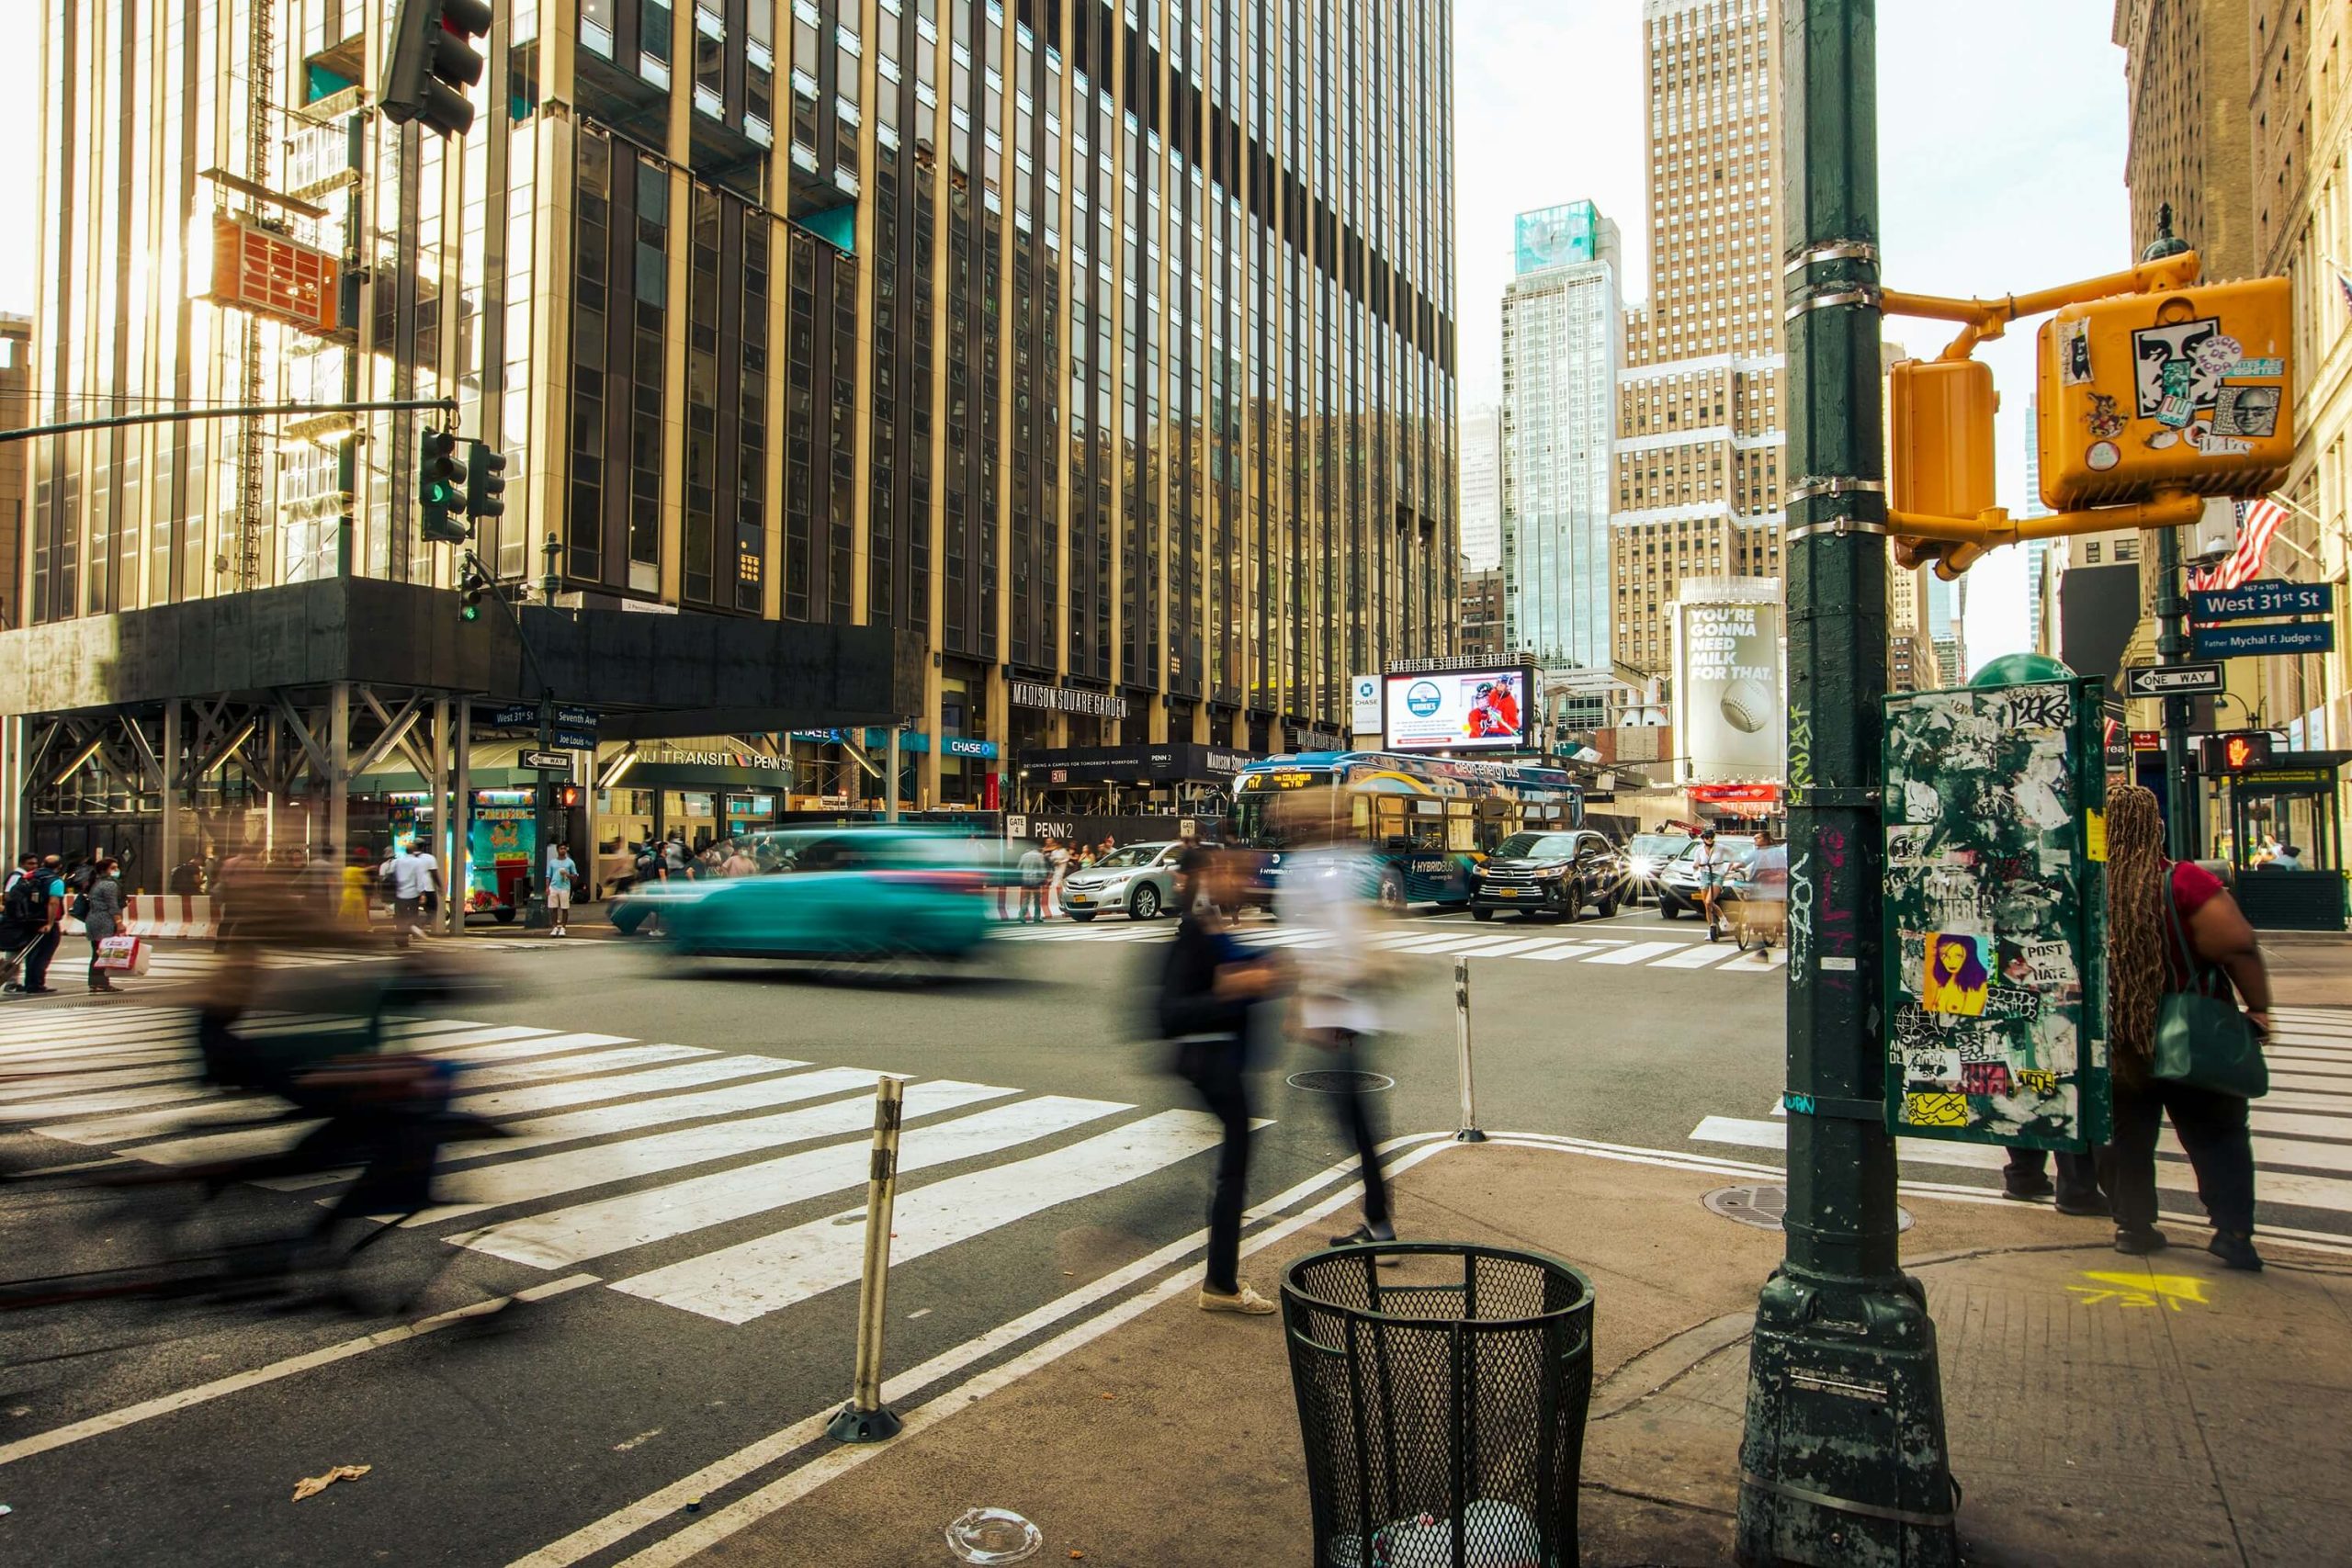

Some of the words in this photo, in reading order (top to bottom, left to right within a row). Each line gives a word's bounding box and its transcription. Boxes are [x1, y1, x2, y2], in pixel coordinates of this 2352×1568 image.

[2206, 337, 2242, 355] CICLO
[2210, 349, 2228, 359] DE
[2198, 355, 2233, 372] MODA
[2206, 595, 2256, 613] West
[2260, 592, 2294, 610] 31st
[2299, 592, 2320, 607] St
[1690, 608, 1756, 622] YOU'RE
[1690, 623, 1757, 637] GONNA
[1690, 637, 1736, 651] NEED
[2205, 639, 2228, 648] Father
[2230, 634, 2267, 648] Mychal
[2269, 635, 2278, 644] F.
[2279, 633, 2312, 646] Judge
[1391, 657, 1434, 672] MADISON
[1440, 655, 1476, 671] SQUARE
[1481, 652, 1521, 667] GARDEN
[1690, 651, 1737, 665] MILK
[1690, 666, 1727, 680] FOR
[1731, 666, 1773, 680] THAT.
[2144, 675, 2168, 686] ONE
[2180, 672, 2208, 683] WAY
[1012, 682, 1056, 709] MADISON
[1057, 687, 1093, 714] SQUARE
[1094, 695, 1127, 718] GARDEN
[496, 714, 513, 724] West
[526, 711, 534, 720] St
[559, 712, 584, 724] Seventh
[584, 716, 597, 726] Ave
[559, 734, 570, 744] Joe
[570, 736, 584, 746] Louis
[951, 741, 981, 753] CHASE
[637, 750, 657, 763] NJ
[662, 750, 731, 766] TRANSIT
[753, 755, 780, 771] PENN
[1207, 751, 1231, 771] MADISON
[1052, 771, 1066, 781] EXIT
[1283, 773, 1311, 781] COLUMBUS
[1454, 761, 1505, 780] clean-energy
[1506, 765, 1520, 778] bus
[1248, 774, 1261, 789] M7
[1009, 818, 1024, 826] GATE
[1035, 822, 1065, 838] PENN
[1066, 823, 1074, 839] 2
[1417, 861, 1454, 873] HYBRIDBUS
[2028, 943, 2064, 958] POST
